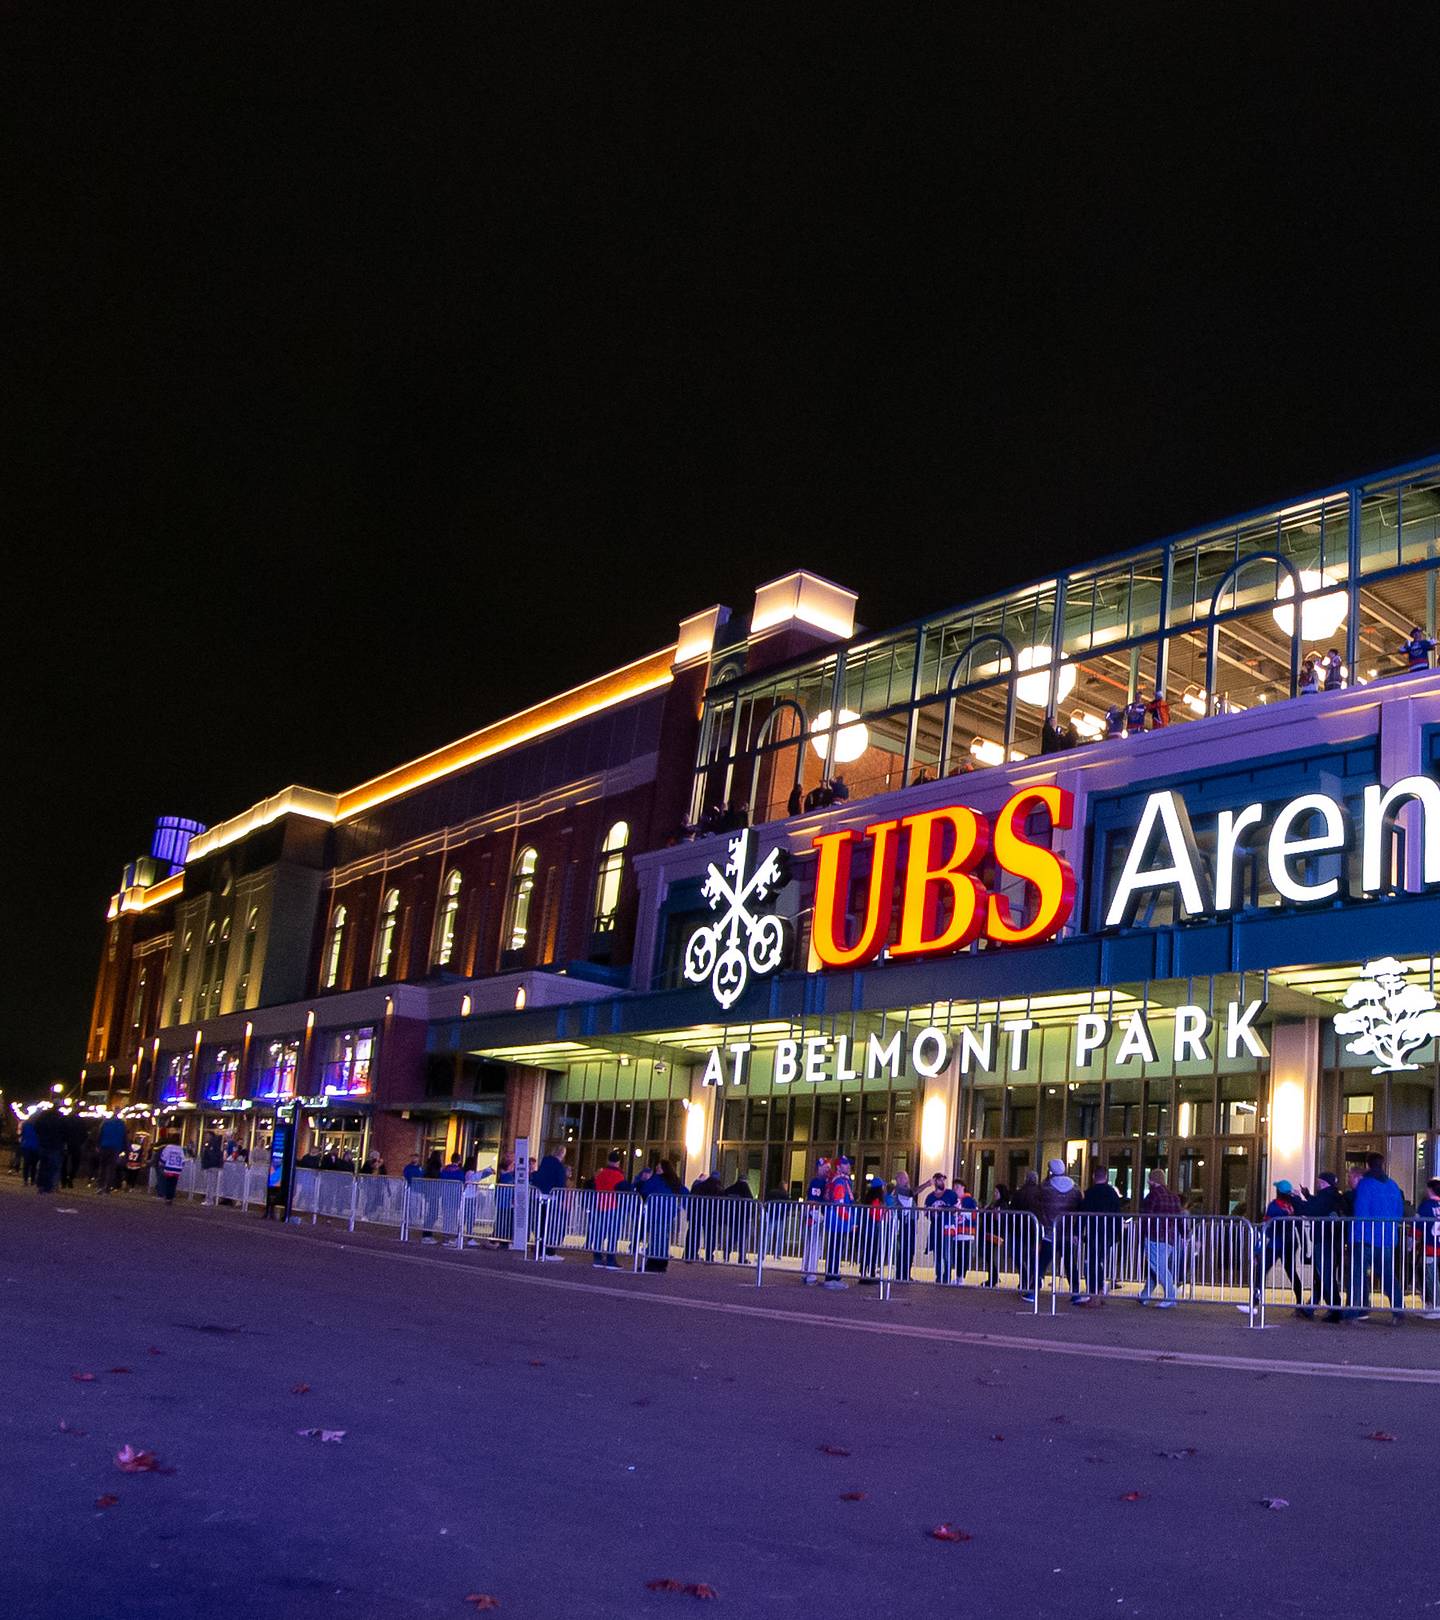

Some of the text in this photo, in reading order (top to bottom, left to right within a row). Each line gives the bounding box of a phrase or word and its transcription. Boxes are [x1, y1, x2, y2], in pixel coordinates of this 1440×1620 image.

[812, 785, 1076, 968] UBS
[702, 999, 1270, 1087] AT BELMONT PARK
